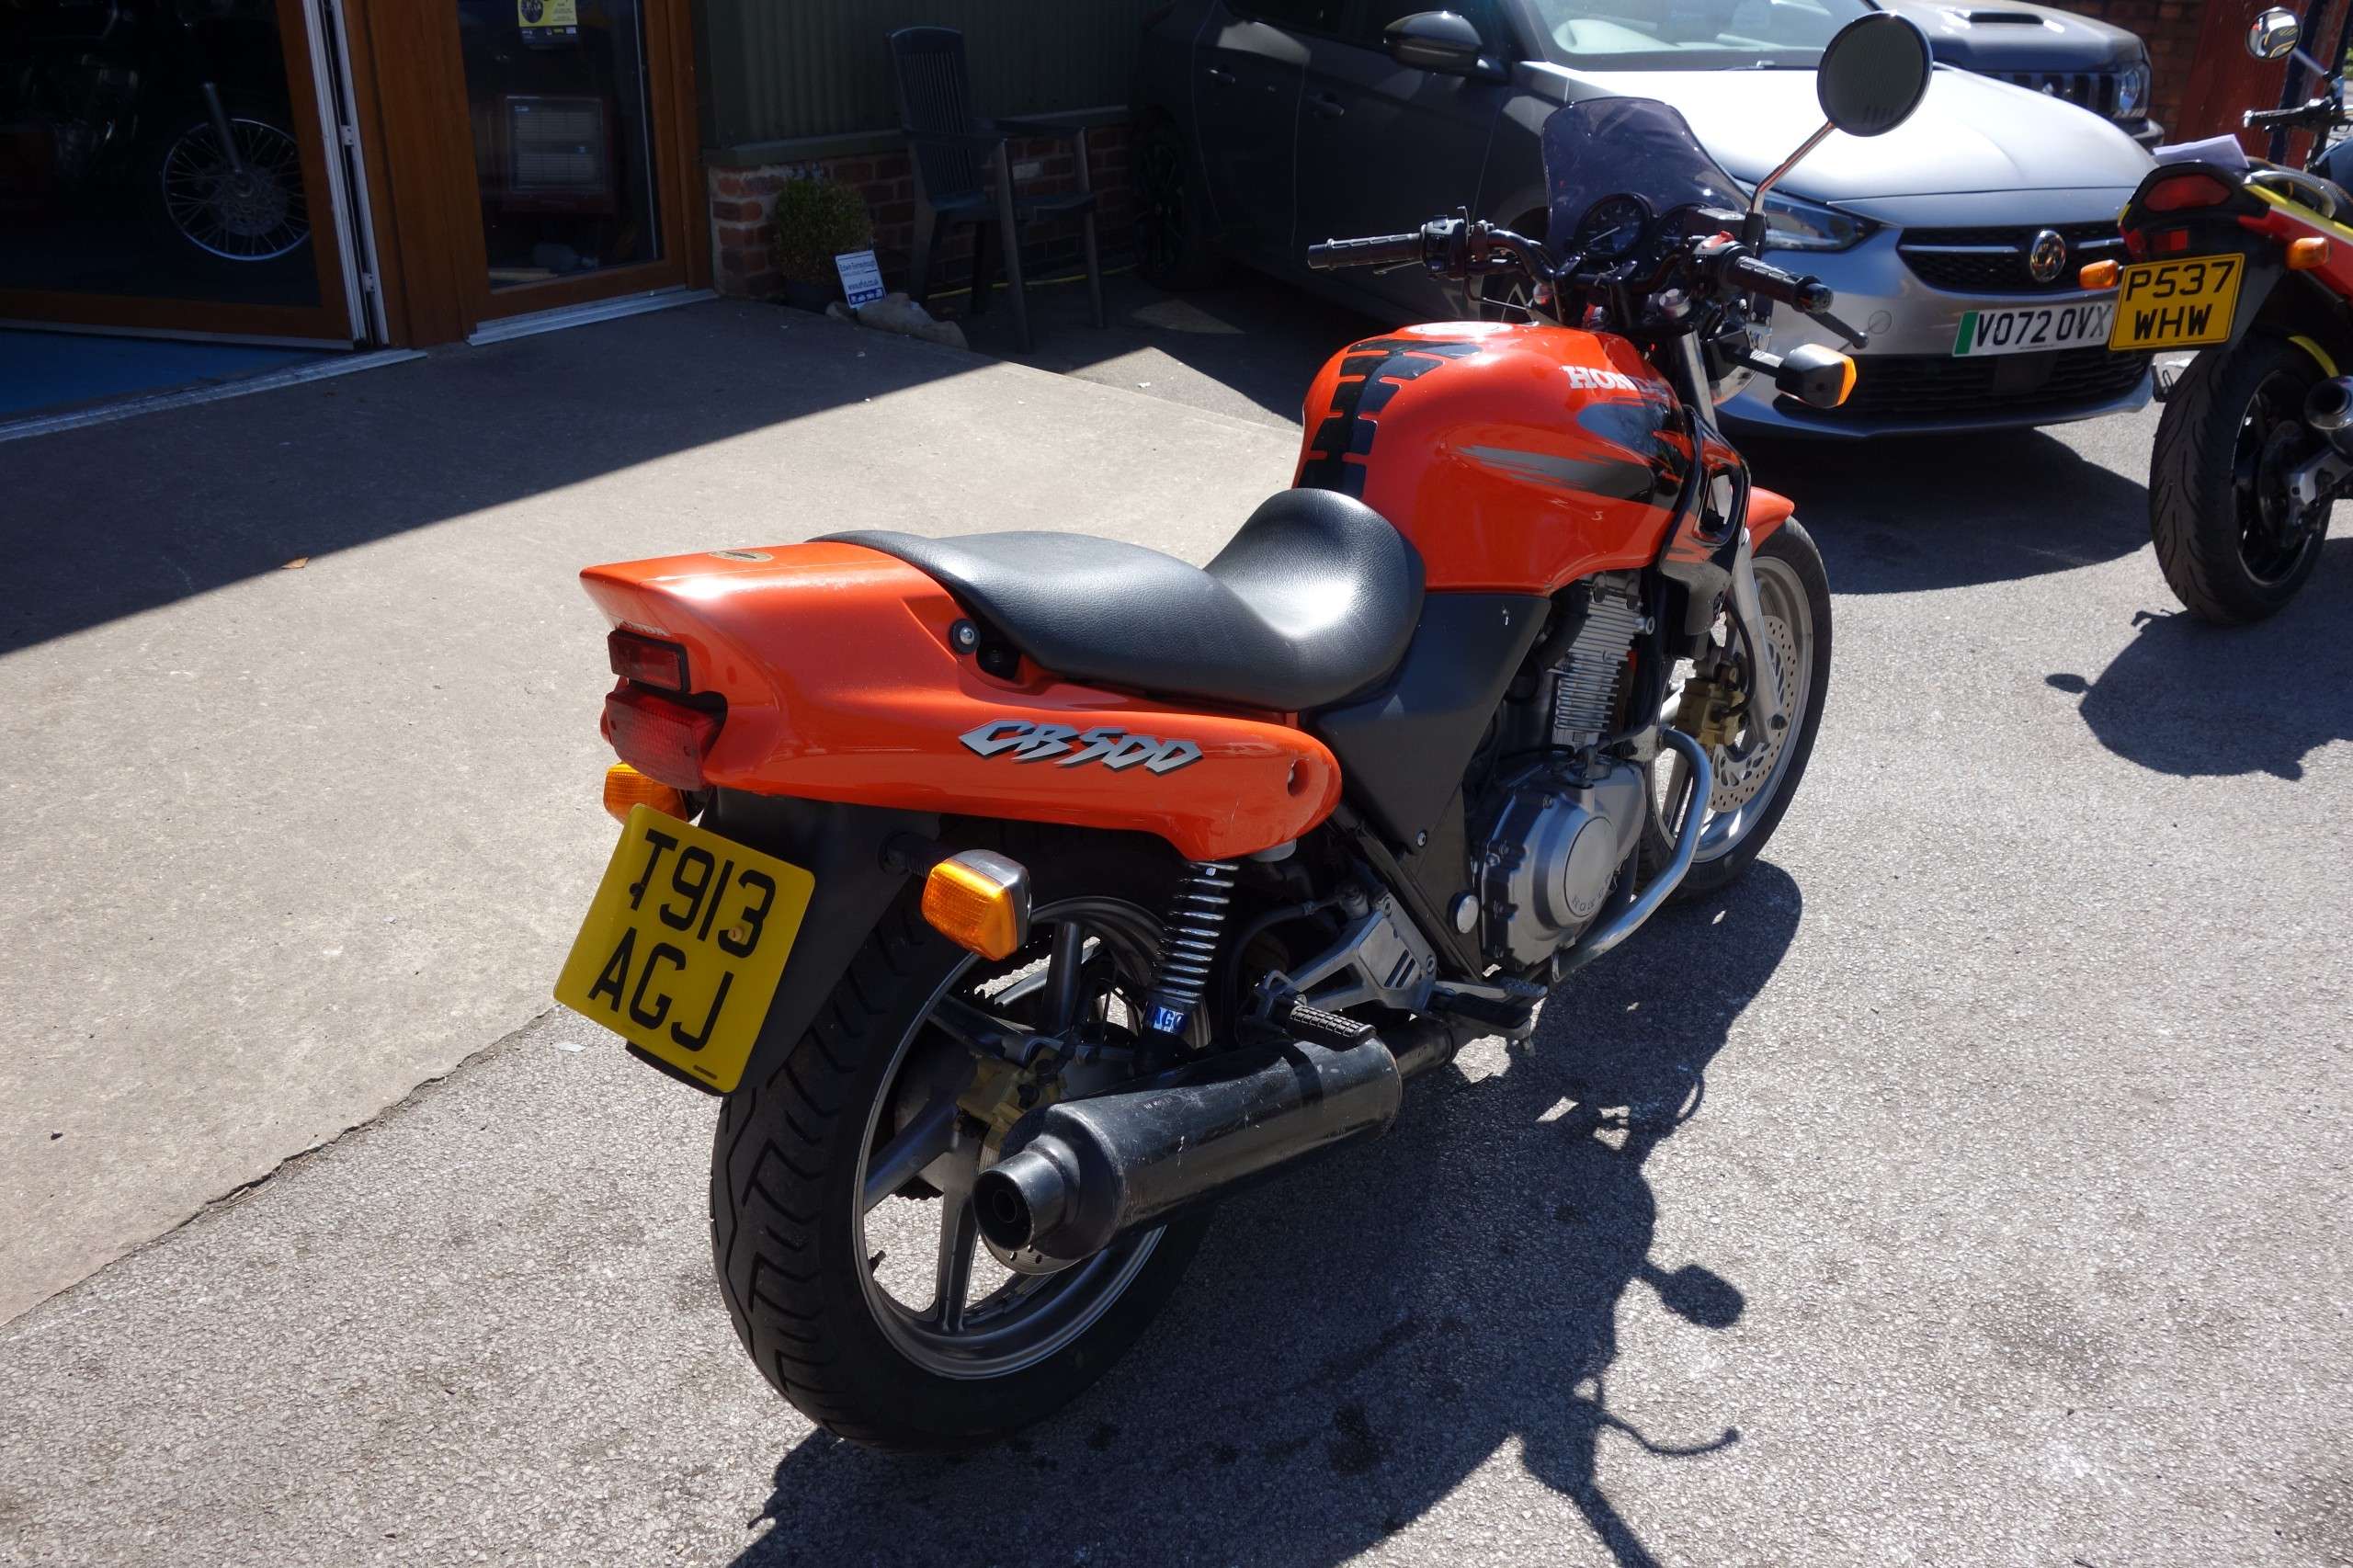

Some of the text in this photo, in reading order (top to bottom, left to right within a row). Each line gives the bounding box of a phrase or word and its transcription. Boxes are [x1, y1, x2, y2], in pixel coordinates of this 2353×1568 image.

[2125, 260, 2236, 302] P537
[2133, 303, 2213, 341] WHW
[959, 719, 1203, 774] CB500
[630, 828, 777, 959] T913
[587, 926, 734, 1052] AGJ
